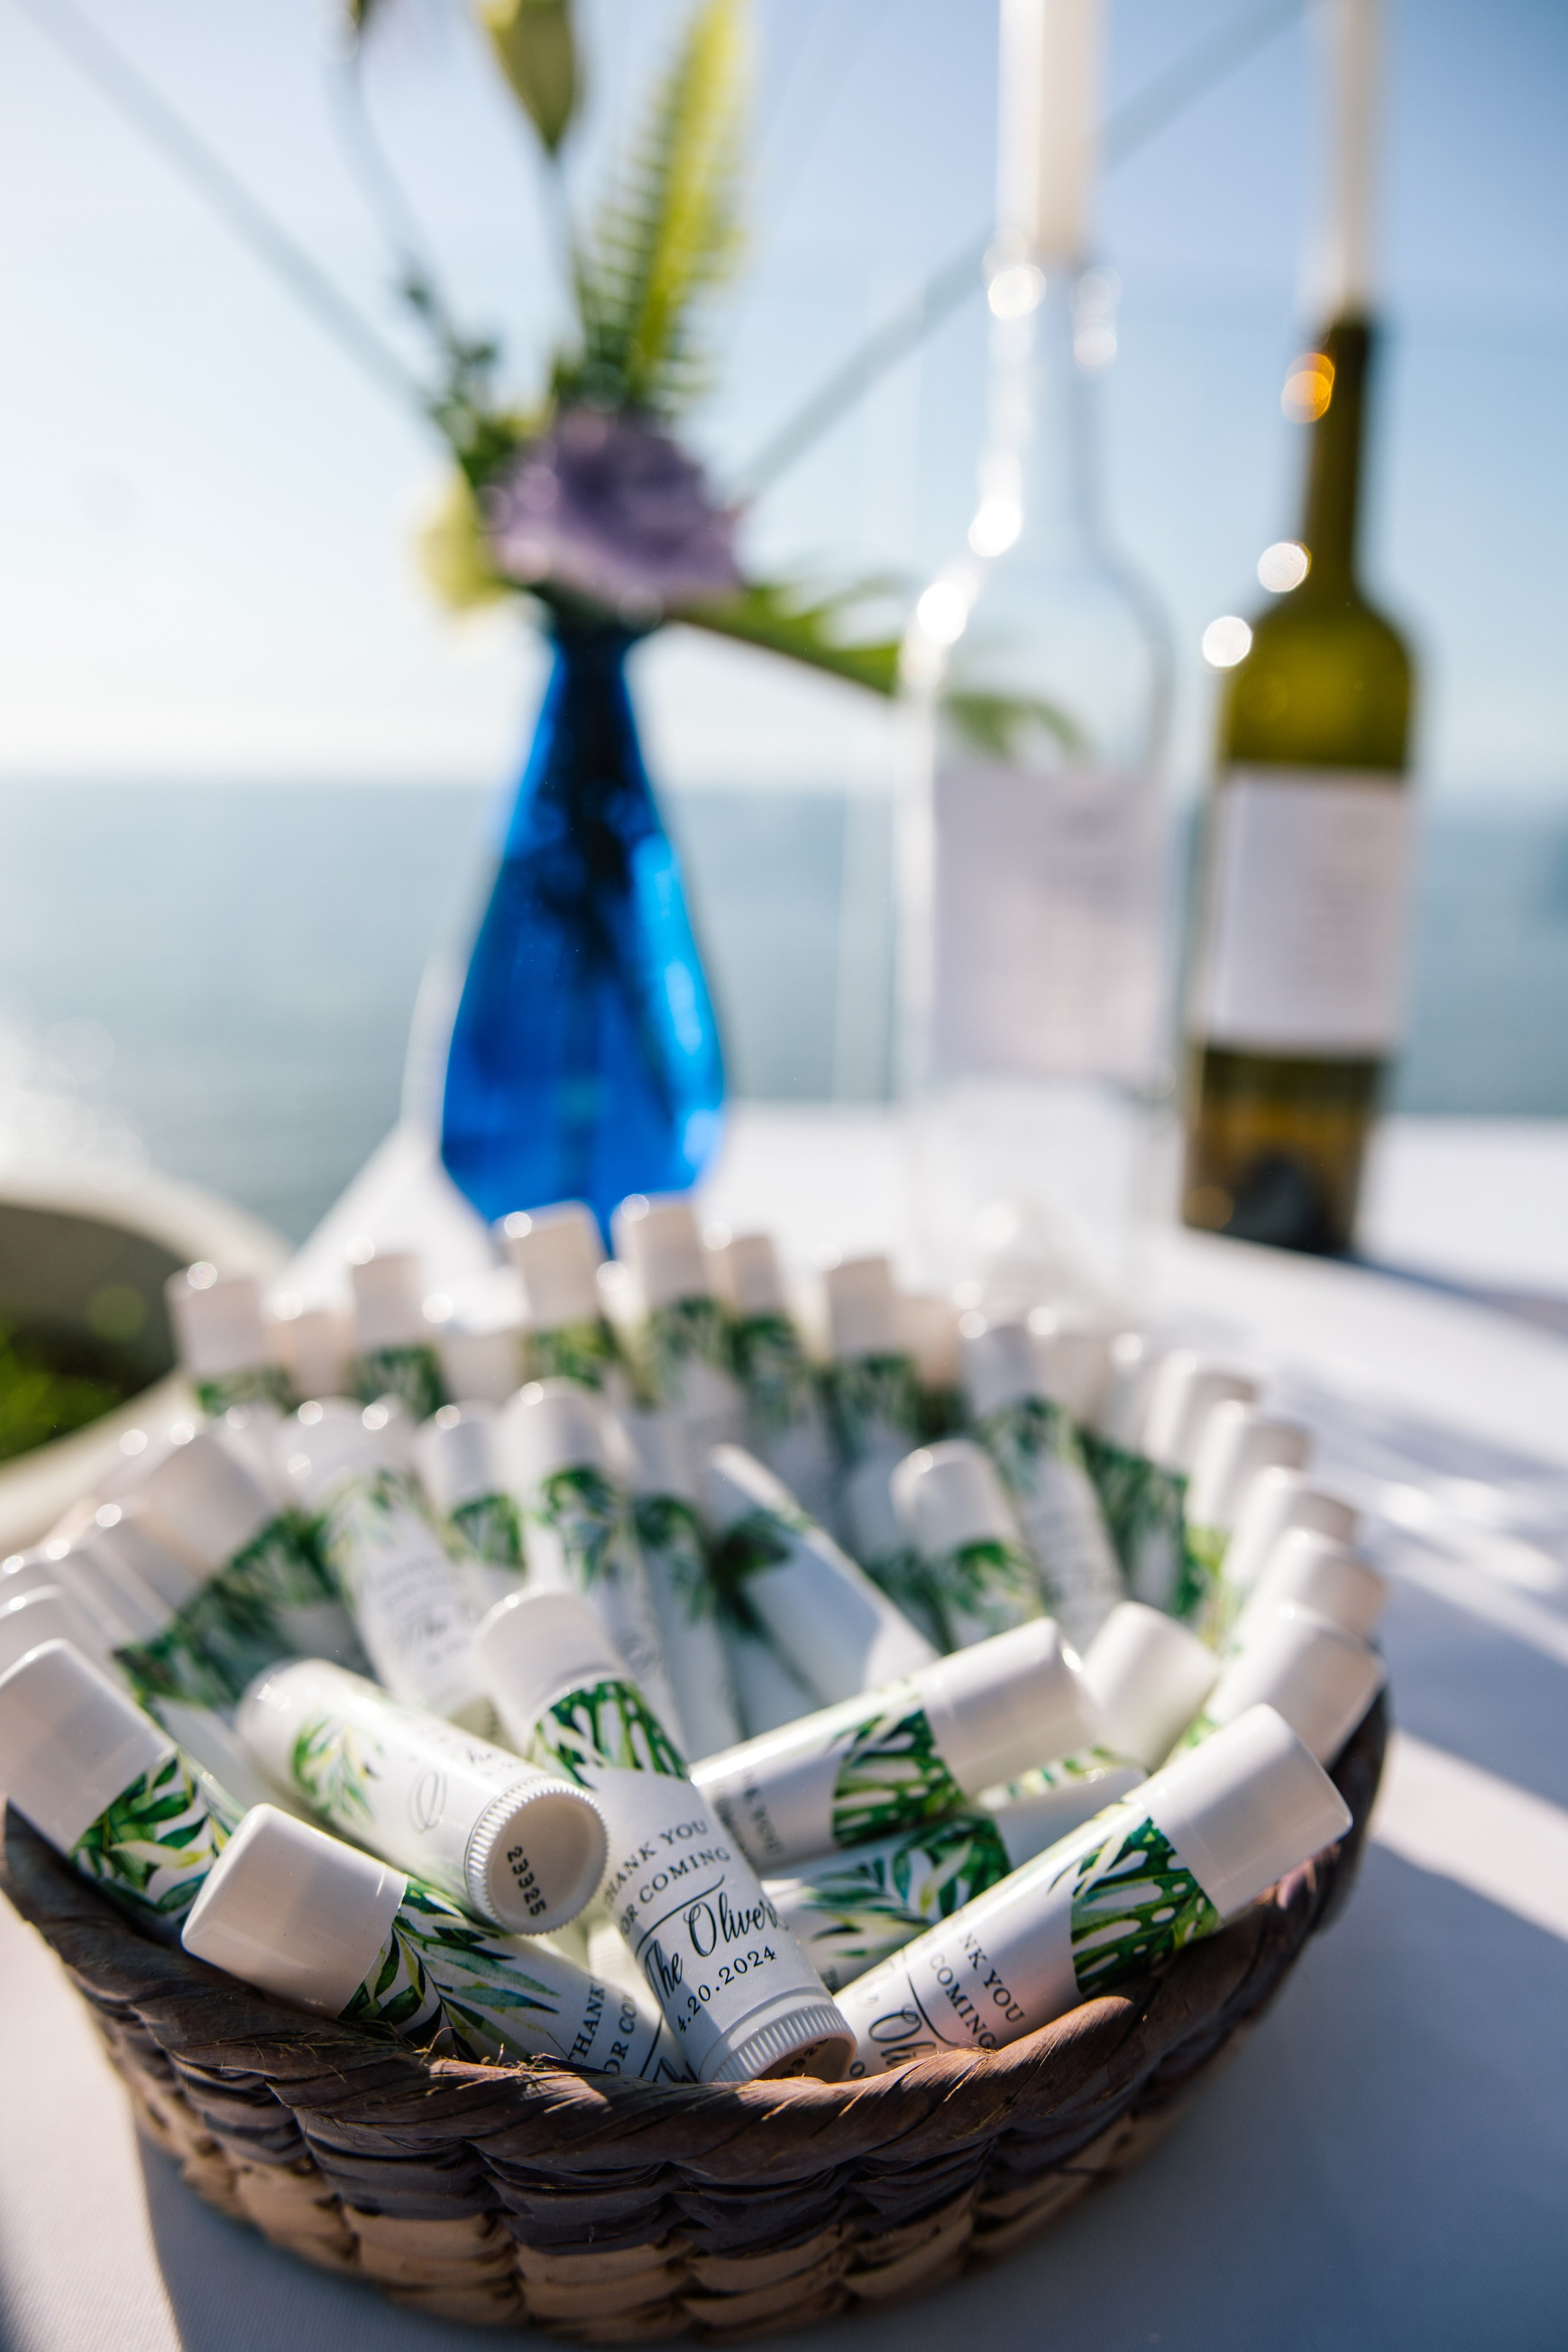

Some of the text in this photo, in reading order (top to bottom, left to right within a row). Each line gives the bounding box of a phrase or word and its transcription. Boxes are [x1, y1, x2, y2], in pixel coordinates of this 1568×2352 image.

[659, 1819, 708, 1845] YOU
[507, 1845, 547, 1917] 23325
[620, 1846, 731, 1936] OR COMING
[677, 1945, 777, 2034] 4.20.2024
[930, 1951, 997, 2049] COMING
[983, 1966, 1025, 2023] YOU
